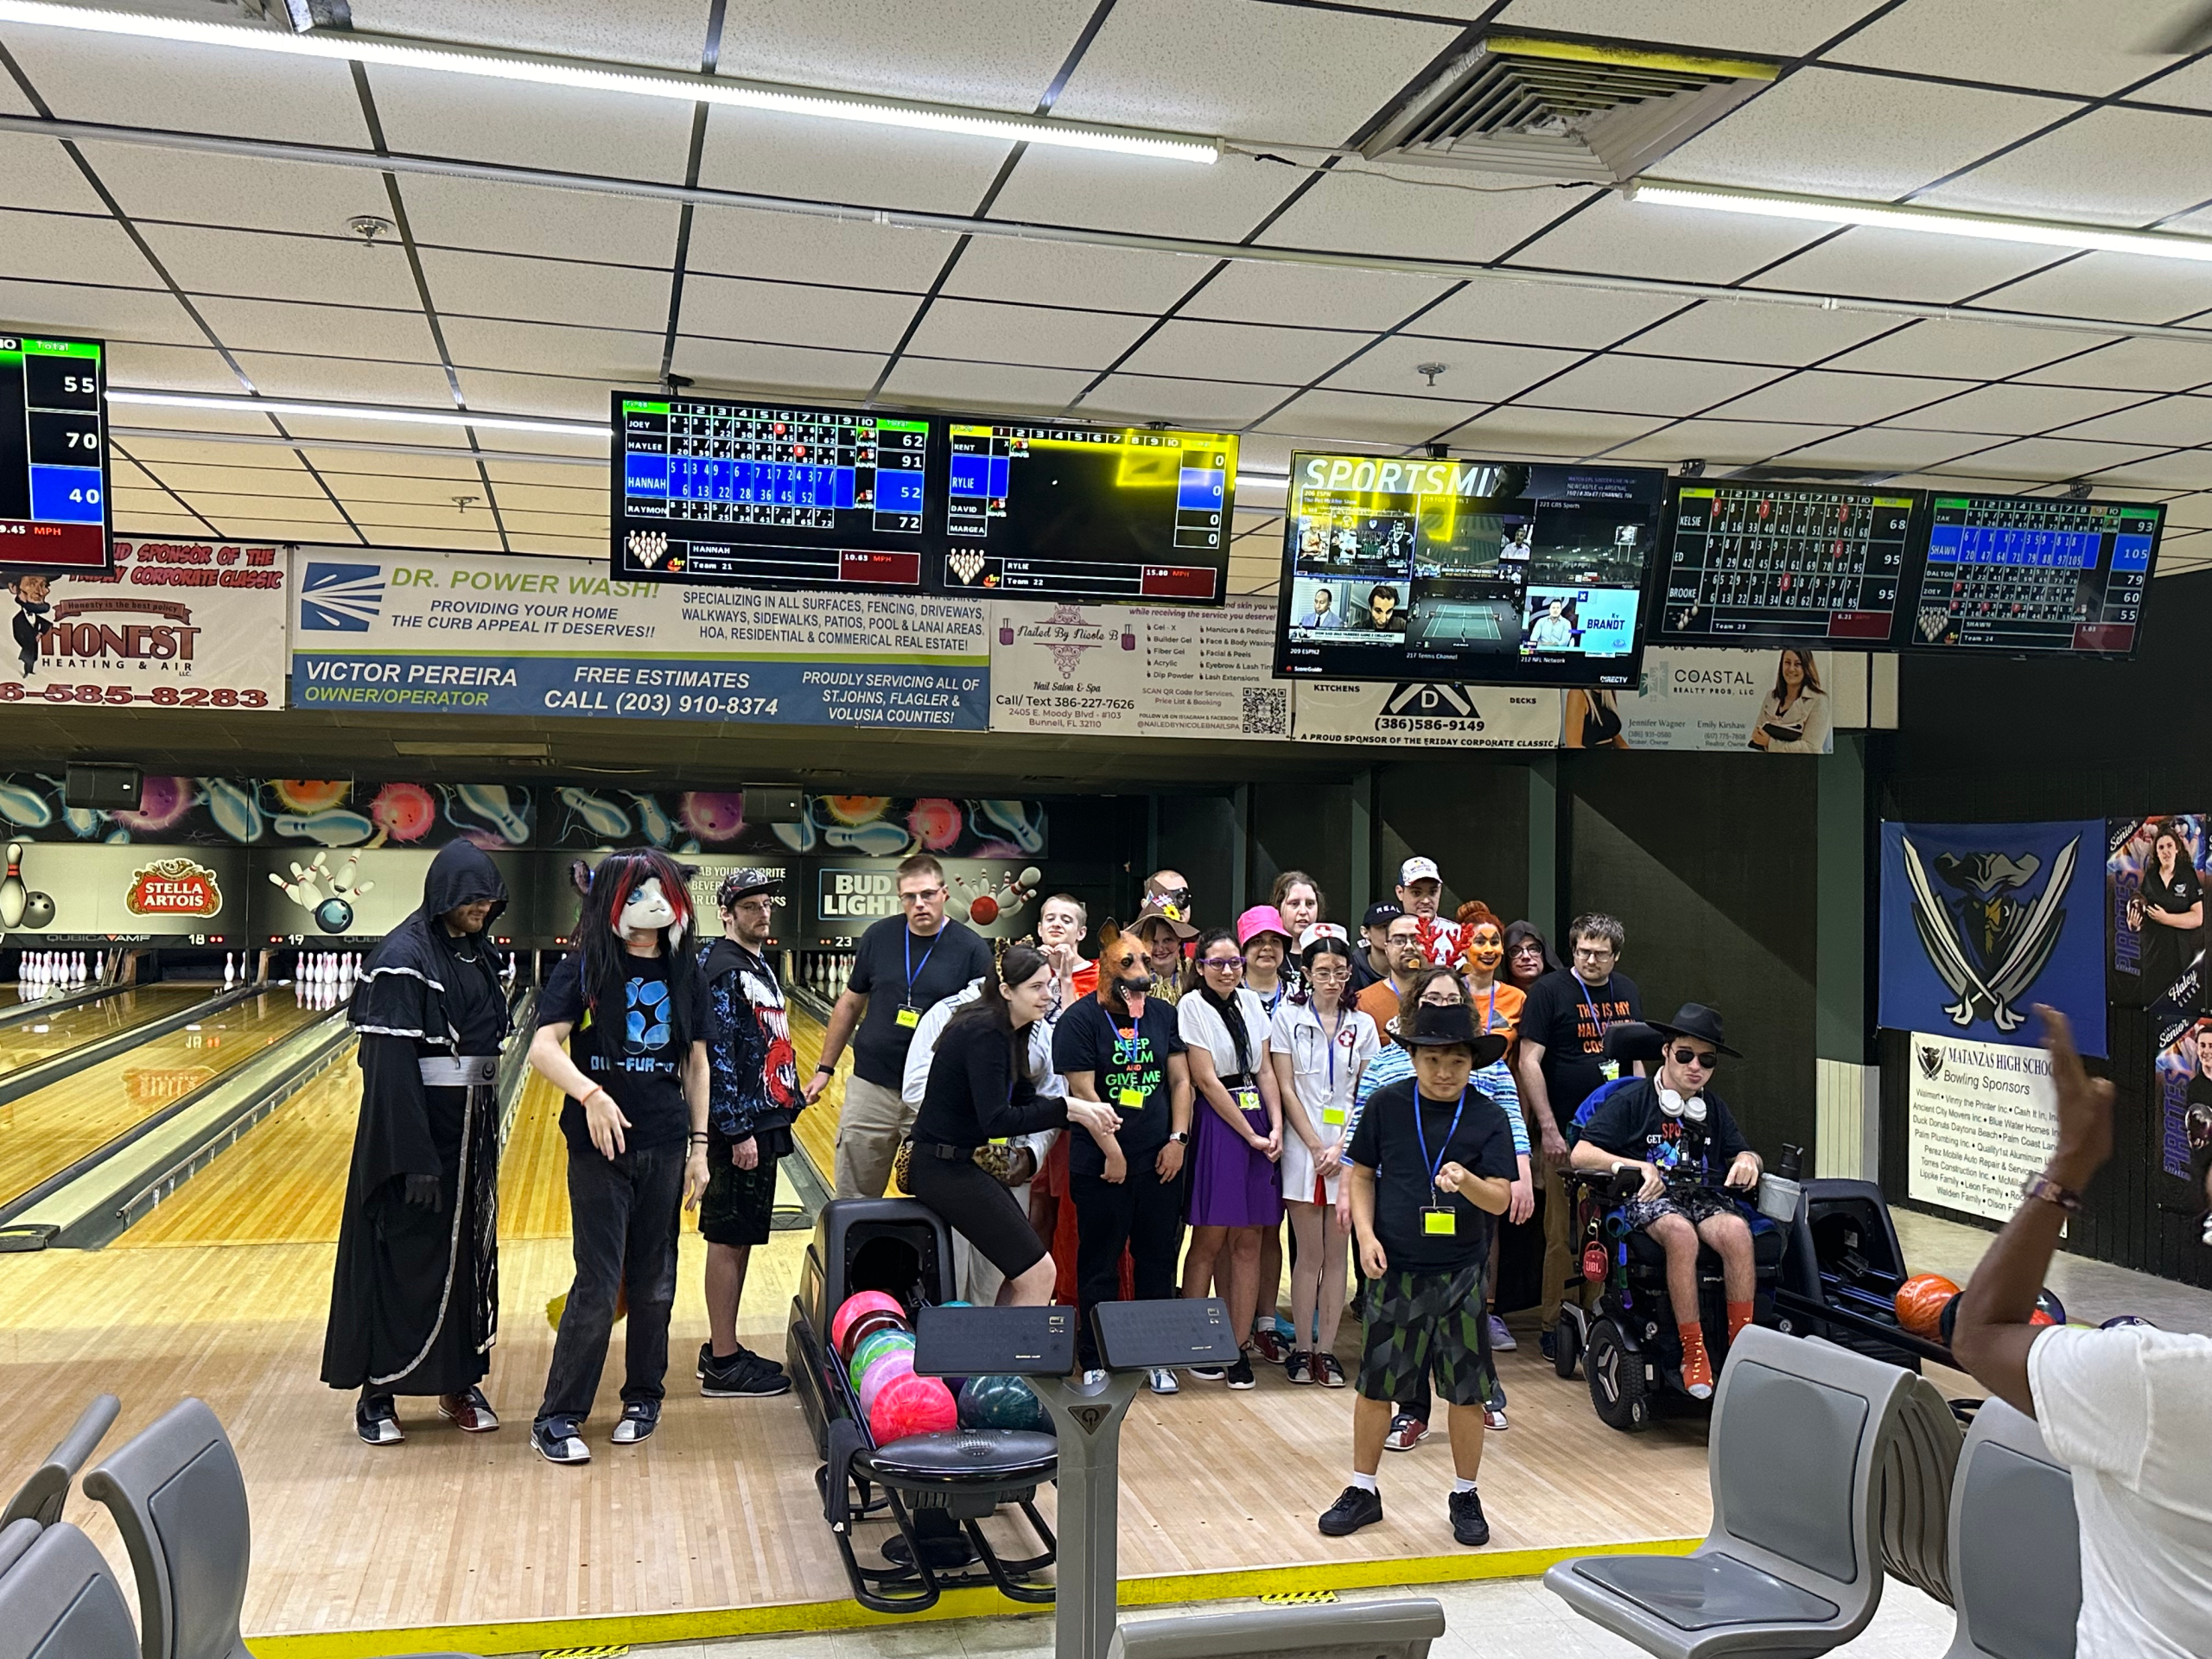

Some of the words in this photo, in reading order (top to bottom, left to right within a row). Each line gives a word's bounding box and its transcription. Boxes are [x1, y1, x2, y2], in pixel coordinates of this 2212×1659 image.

[64, 377, 94, 392] 55
[628, 420, 650, 429] JOEY
[67, 432, 97, 448] 70
[628, 442, 663, 451] HAYLEE
[902, 435, 923, 447] 62
[954, 443, 976, 452] KENT
[902, 455, 922, 468] 91
[628, 478, 666, 489] HANNAH
[952, 477, 974, 489] RYLIE
[69, 489, 99, 504] 40
[900, 486, 920, 499] 52
[951, 505, 977, 513] DAVID
[899, 516, 919, 529] 72
[1680, 516, 1701, 527] KELSIE
[1890, 520, 1906, 530] 68
[2138, 522, 2153, 532] 93
[34, 527, 61, 536] MPH
[137, 544, 212, 565] SPONSOR
[217, 547, 240, 565] OF
[246, 549, 276, 566] THE
[874, 555, 892, 563] MPH
[1675, 551, 1683, 562] ED
[1884, 555, 1900, 565] 95
[1930, 545, 1956, 556] SHAWN
[2124, 549, 2148, 559] 105
[693, 561, 719, 570] Team
[721, 562, 733, 570] 21
[131, 566, 219, 587] CORPORATE
[219, 571, 284, 589] CLASSIC
[391, 567, 440, 588] DR.
[450, 570, 560, 594] POWER
[569, 576, 661, 598] WASH!
[1669, 588, 1697, 598] BROOKE
[1878, 589, 1894, 600] 95
[68, 601, 102, 610] Honesty
[131, 601, 150, 610] best
[152, 604, 178, 613] policy
[430, 600, 518, 615] PROVIDING
[524, 604, 569, 617] YOUR
[572, 607, 618, 620] HOME
[683, 592, 761, 607] SPECIALIZING
[765, 596, 775, 607] IN
[779, 597, 799, 608] ALL
[803, 597, 864, 613] SURFACES,
[868, 601, 917, 616] FENCING,
[921, 605, 984, 620] DRIVEWAYS,
[1152, 609, 1185, 618] receiving
[391, 615, 423, 627] THE
[428, 616, 473, 630] CURB
[476, 619, 539, 632] APPEAL
[544, 622, 559, 632] IT
[563, 623, 655, 638] DESERVES!!
[682, 608, 750, 625] WALKWAYS,
[753, 612, 821, 628] SIDEWALKS,
[825, 616, 865, 630] PATIOS,
[869, 618, 899, 631] POOL
[902, 620, 909, 631] &
[912, 621, 944, 632] LANAI
[946, 624, 984, 635] AREAS.
[1587, 620, 1625, 630] BRANDT
[700, 626, 727, 640] HOA,
[731, 628, 804, 642] RESIDENTIAL
[808, 632, 815, 642] &
[818, 632, 892, 646] COMMERICAL
[895, 636, 923, 647] REAL
[926, 638, 968, 651] ESTATE!
[1017, 626, 1051, 638] Nailed
[1054, 627, 1069, 641] By
[1073, 628, 1105, 640] Nicole
[1109, 630, 1119, 640] B
[41, 623, 201, 660] HONEST
[42, 658, 124, 669] HEATING
[306, 661, 401, 683] VICTOR
[408, 664, 518, 686] PEREIRA
[575, 666, 631, 684] FREE
[635, 670, 750, 689] ESTIMATES
[803, 671, 863, 686] PROUDLY
[866, 674, 933, 688] SERVICING
[936, 677, 958, 690] ALL
[963, 678, 980, 690] OF
[1675, 670, 1754, 684] COASTAL
[1033, 682, 1050, 690] Nail
[1052, 683, 1073, 691] Salon
[1077, 683, 1084, 691] &
[1086, 683, 1101, 694] Spa
[305, 686, 489, 706] OWNER/OPERATOR
[544, 690, 608, 709] CALL
[616, 692, 671, 715] (203)
[678, 696, 779, 715] 910-8374
[823, 690, 886, 706] ST.JOHNS,
[890, 693, 949, 706] FLAGLER
[951, 696, 960, 706] &
[996, 695, 1024, 706] Call/
[1027, 696, 1052, 706] Text
[1054, 697, 1135, 709] 386-227-7626
[1421, 690, 1439, 708] D
[829, 708, 883, 721] VOLUSIA
[887, 709, 954, 723] COUNTIES!
[1375, 717, 1484, 732] (386)586-9149
[2110, 820, 2138, 852] Senior
[144, 882, 202, 894] STELLA
[836, 874, 891, 894] BUD
[144, 894, 204, 907] ARTOIS
[824, 895, 905, 915] LIGHT
[189, 934, 205, 944] 18
[288, 934, 304, 945] 19
[836, 937, 852, 947] 23
[2168, 969, 2197, 1001] Haley
[1576, 1003, 1600, 1019] THS
[1602, 1002, 1612, 1018] IS
[1614, 1001, 1630, 1017] MY
[1114, 1038, 1149, 1051] KEEP
[1112, 1051, 1154, 1065] CALM
[1948, 1047, 1994, 1068] MATANZAS
[1996, 1054, 2021, 1071] HIGH
[1105, 1072, 1138, 1085] GIVE
[1142, 1071, 1160, 1084] ME
[1944, 1070, 1979, 1090] Bowling
[1982, 1076, 2030, 1095] Sponsors
[1975, 1100, 1996, 1110] Printer
[1647, 1135, 1662, 1143] GET
